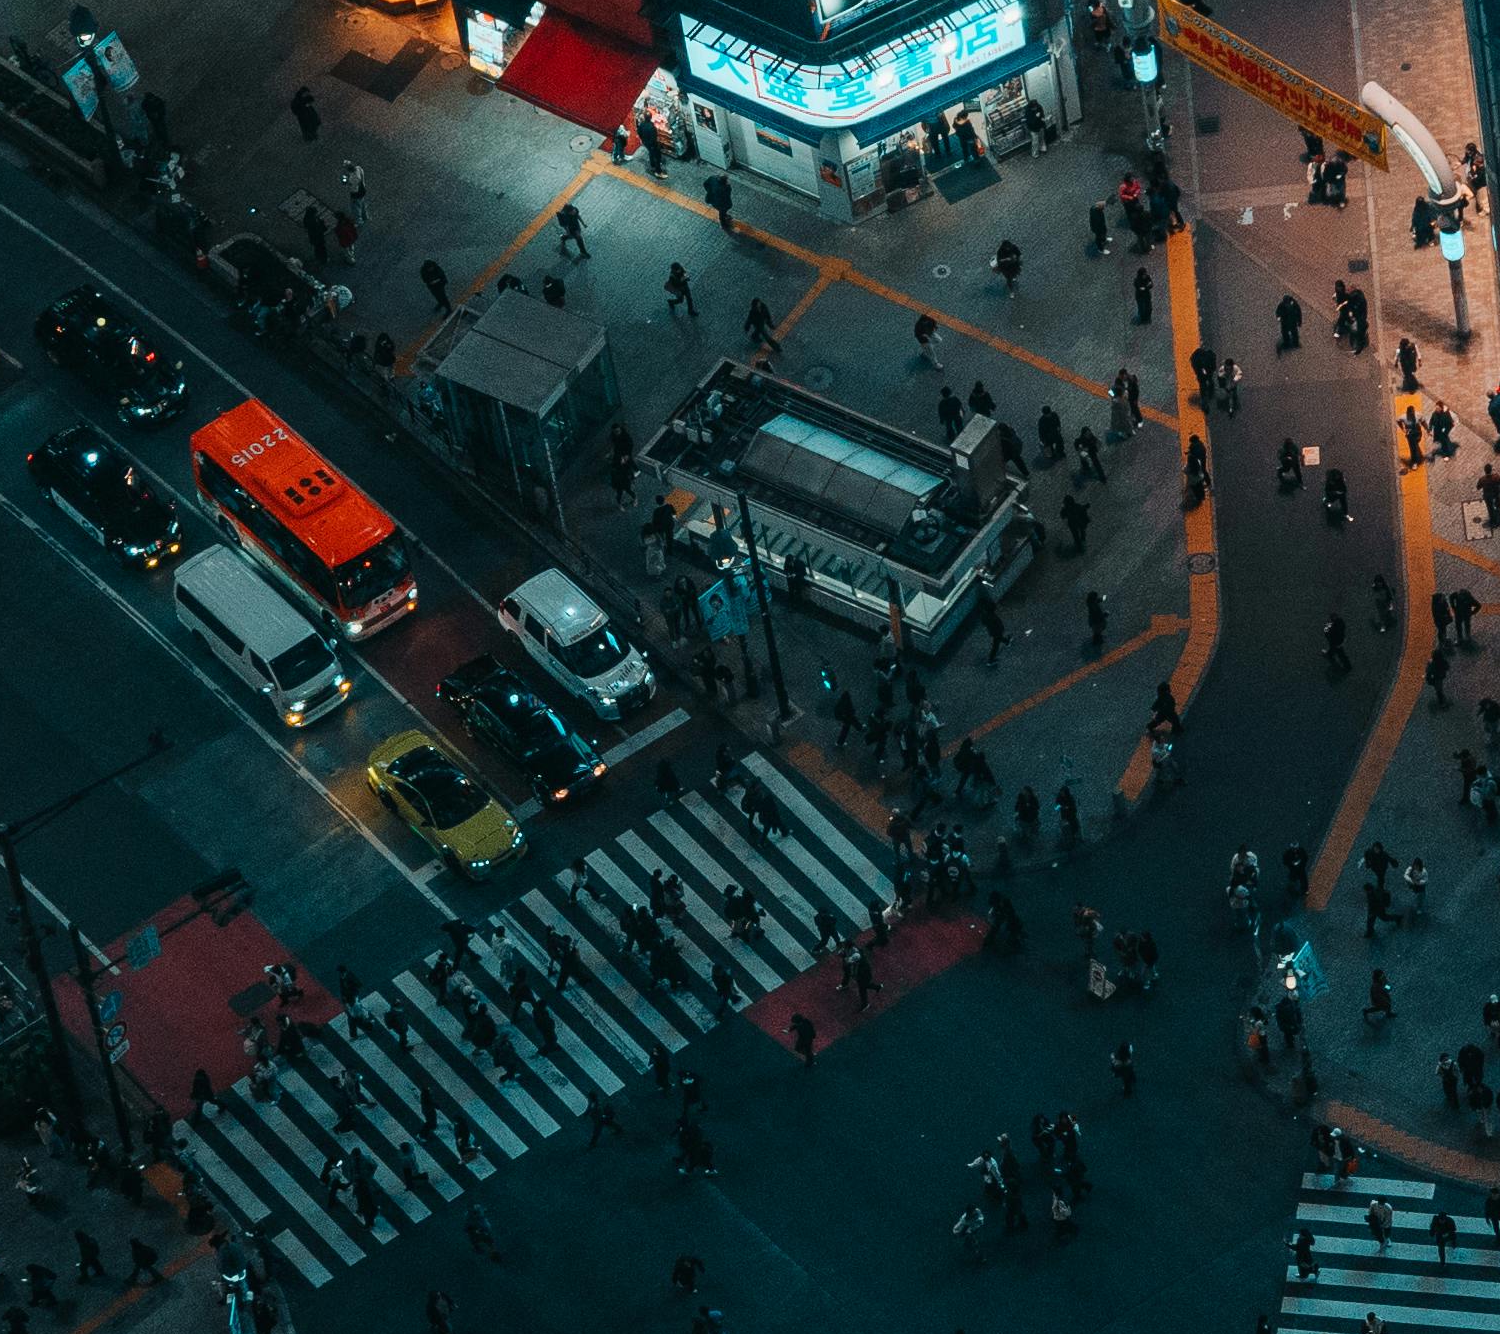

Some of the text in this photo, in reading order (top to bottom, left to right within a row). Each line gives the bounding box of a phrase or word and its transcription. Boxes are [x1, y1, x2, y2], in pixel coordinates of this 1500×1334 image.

[702, 11, 1001, 113] 大盛堂書店
[229, 424, 290, 470] 22015
